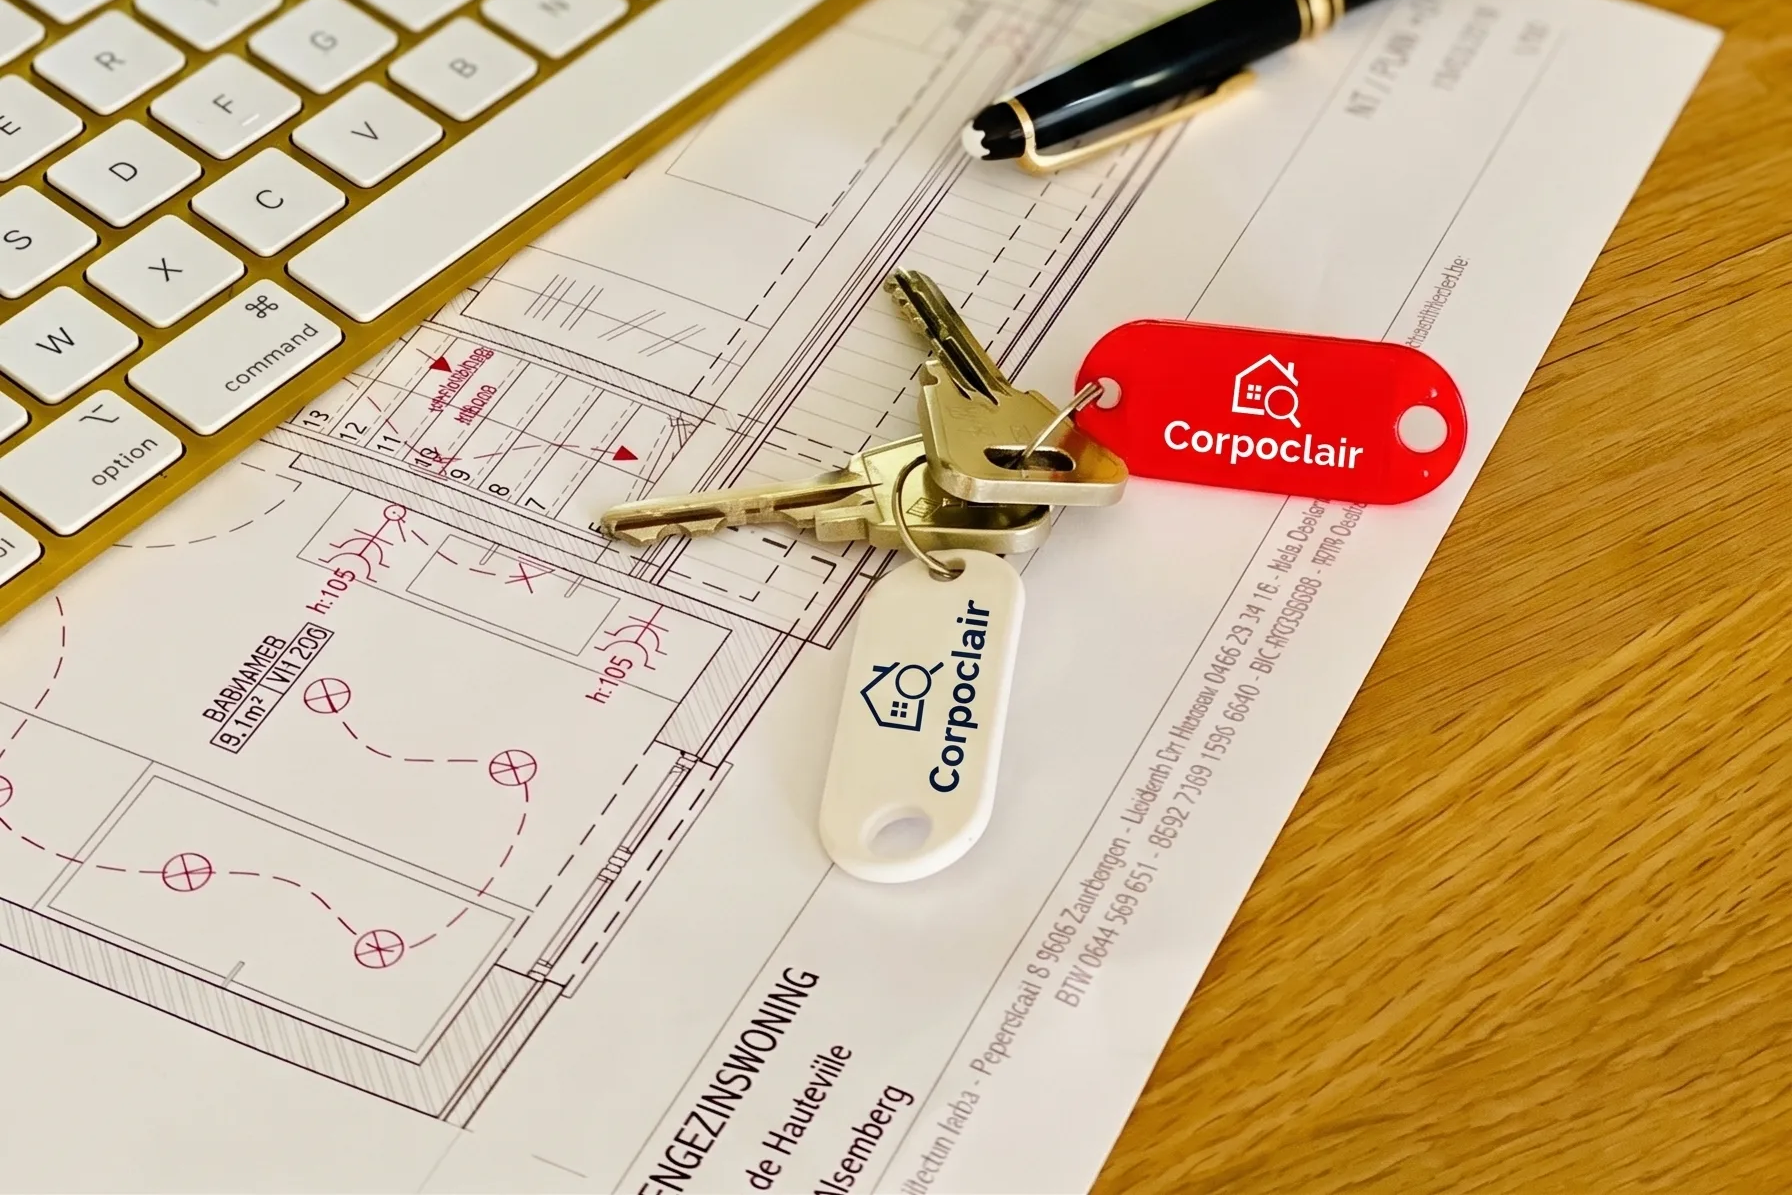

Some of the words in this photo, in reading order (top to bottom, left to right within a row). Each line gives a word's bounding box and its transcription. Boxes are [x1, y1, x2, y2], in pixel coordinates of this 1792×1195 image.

[309, 29, 338, 53] G
[94, 51, 126, 72] R
[449, 57, 479, 80] B
[212, 93, 234, 115] F
[0, 114, 21, 136] E
[350, 120, 381, 144] V
[108, 161, 139, 183] D
[255, 189, 285, 211] C
[3, 229, 33, 251] S
[148, 257, 184, 283] X
[36, 326, 76, 356] W
[224, 322, 320, 395] command
[303, 409, 330, 429] 13
[340, 421, 367, 443] 12
[377, 433, 401, 453] 11
[1164, 419, 1364, 469] Corpoclair
[91, 437, 160, 487] option
[450, 469, 471, 482] 9
[488, 483, 511, 497] 8
[525, 496, 547, 512] 7
[306, 567, 356, 615] h:105
[585, 655, 634, 704] h:105
[929, 599, 990, 793] Corpoclair
[1054, 964, 1093, 1008] BTW
[1078, 926, 1119, 970] 0644
[1104, 893, 1139, 926] 569
[1124, 861, 1159, 893] 651
[1223, 683, 1260, 723] 6640
[1249, 647, 1281, 675] BIC
[746, 1159, 783, 1192] de
